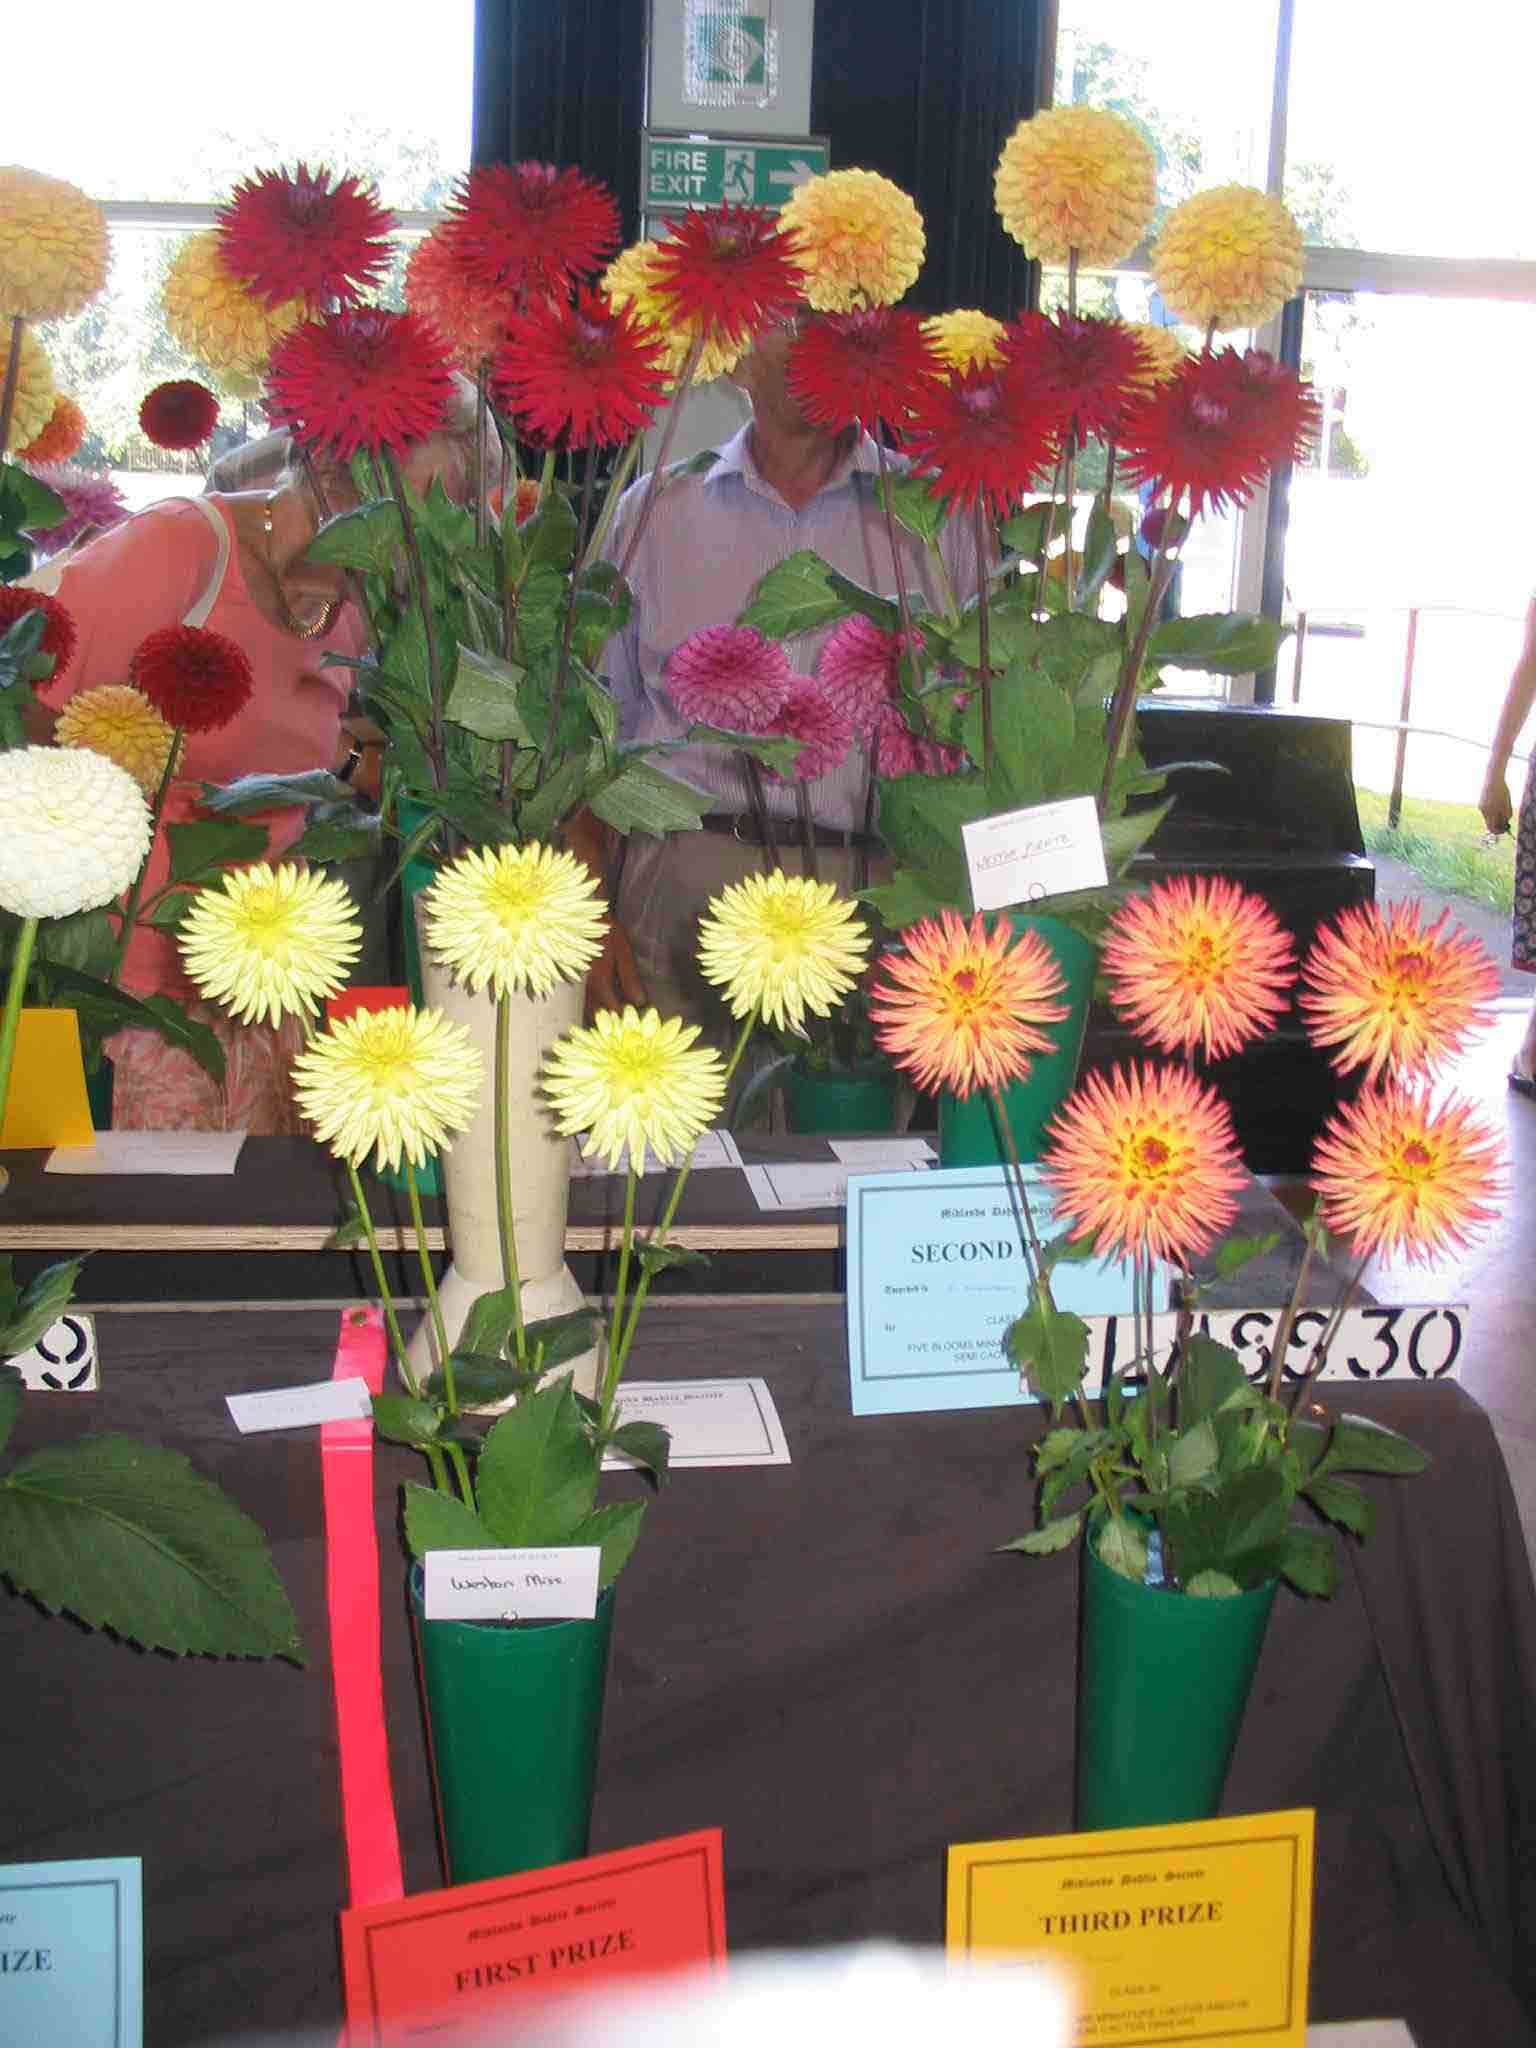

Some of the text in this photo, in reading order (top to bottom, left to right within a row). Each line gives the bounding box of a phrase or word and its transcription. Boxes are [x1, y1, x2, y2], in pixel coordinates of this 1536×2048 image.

[650, 151, 708, 171] FIRE
[650, 175, 707, 194] EXIT
[911, 1240, 1013, 1264] SECOND
[1347, 1309, 1462, 1379] 30
[1041, 1901, 1224, 1936] THIRD PRIZE
[0, 1948, 52, 1974] IZE
[455, 1928, 636, 1992] FIRST PRIZE
